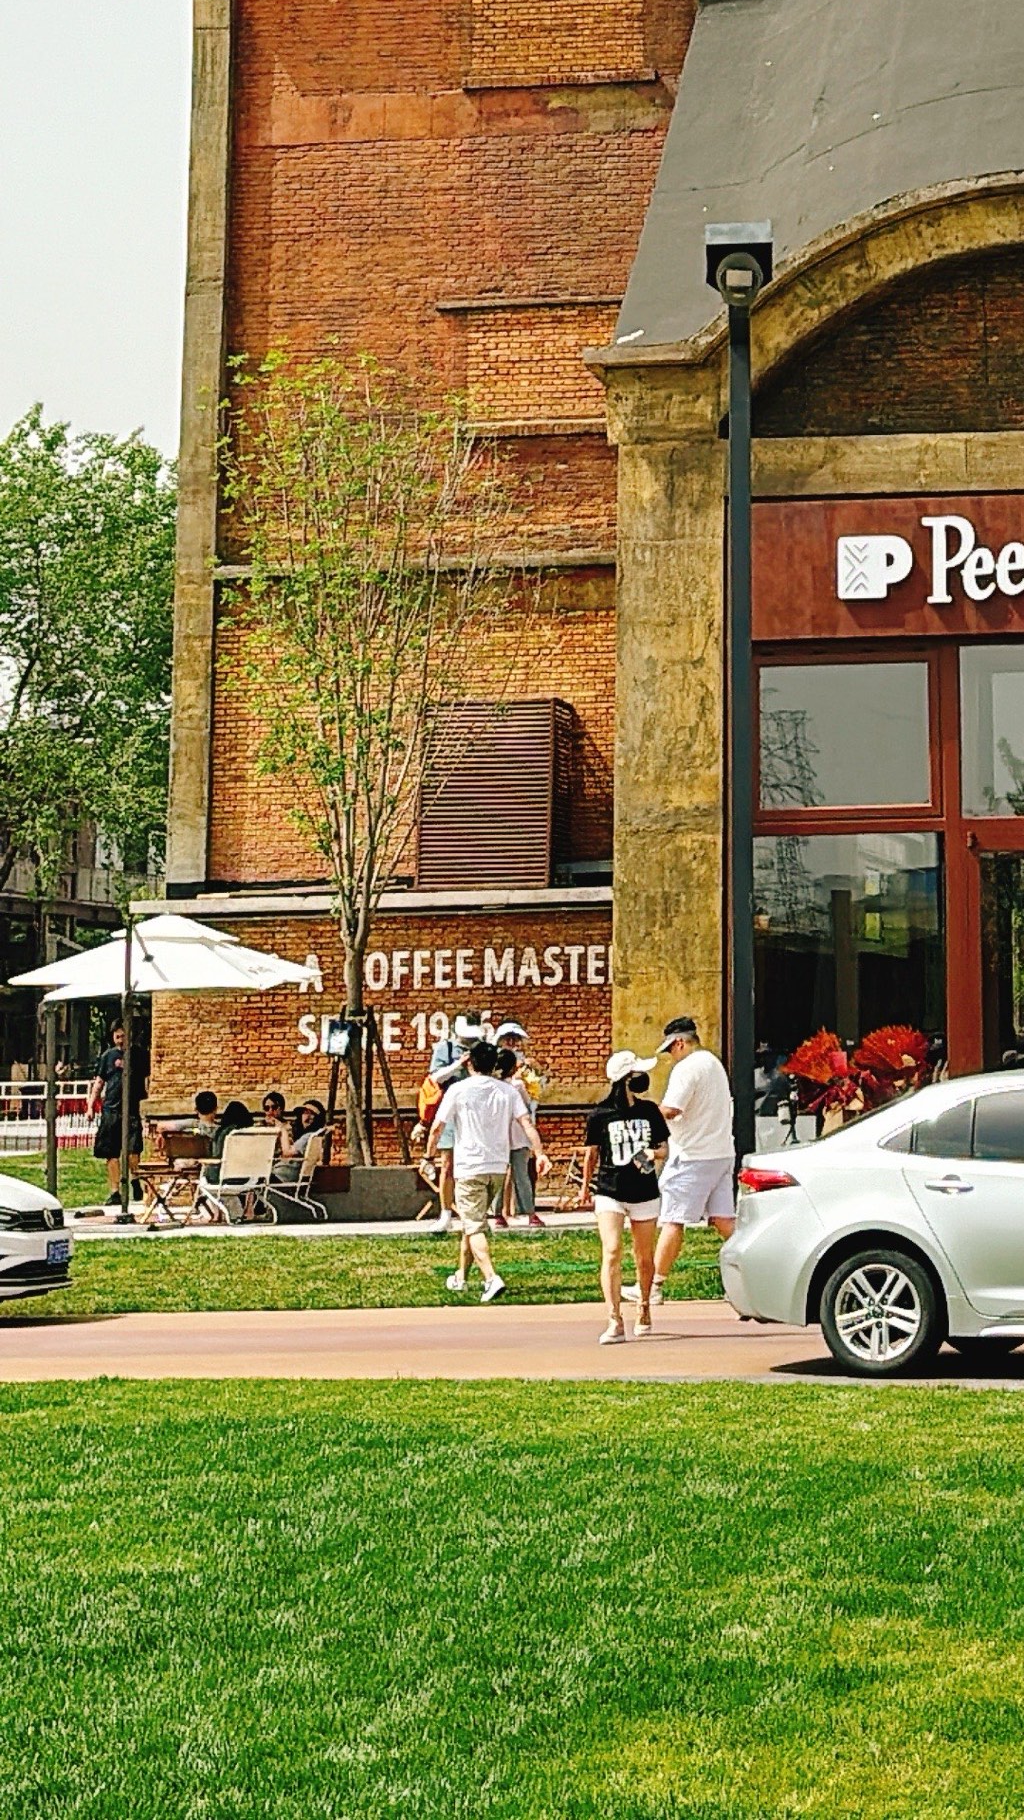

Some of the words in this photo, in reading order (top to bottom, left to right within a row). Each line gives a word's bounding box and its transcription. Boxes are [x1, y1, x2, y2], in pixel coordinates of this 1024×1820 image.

[299, 954, 324, 993] A
[343, 948, 474, 991] OFFEE
[483, 945, 613, 987] MASTE
[297, 1012, 403, 1055] SIE
[409, 1010, 496, 1051] 196
